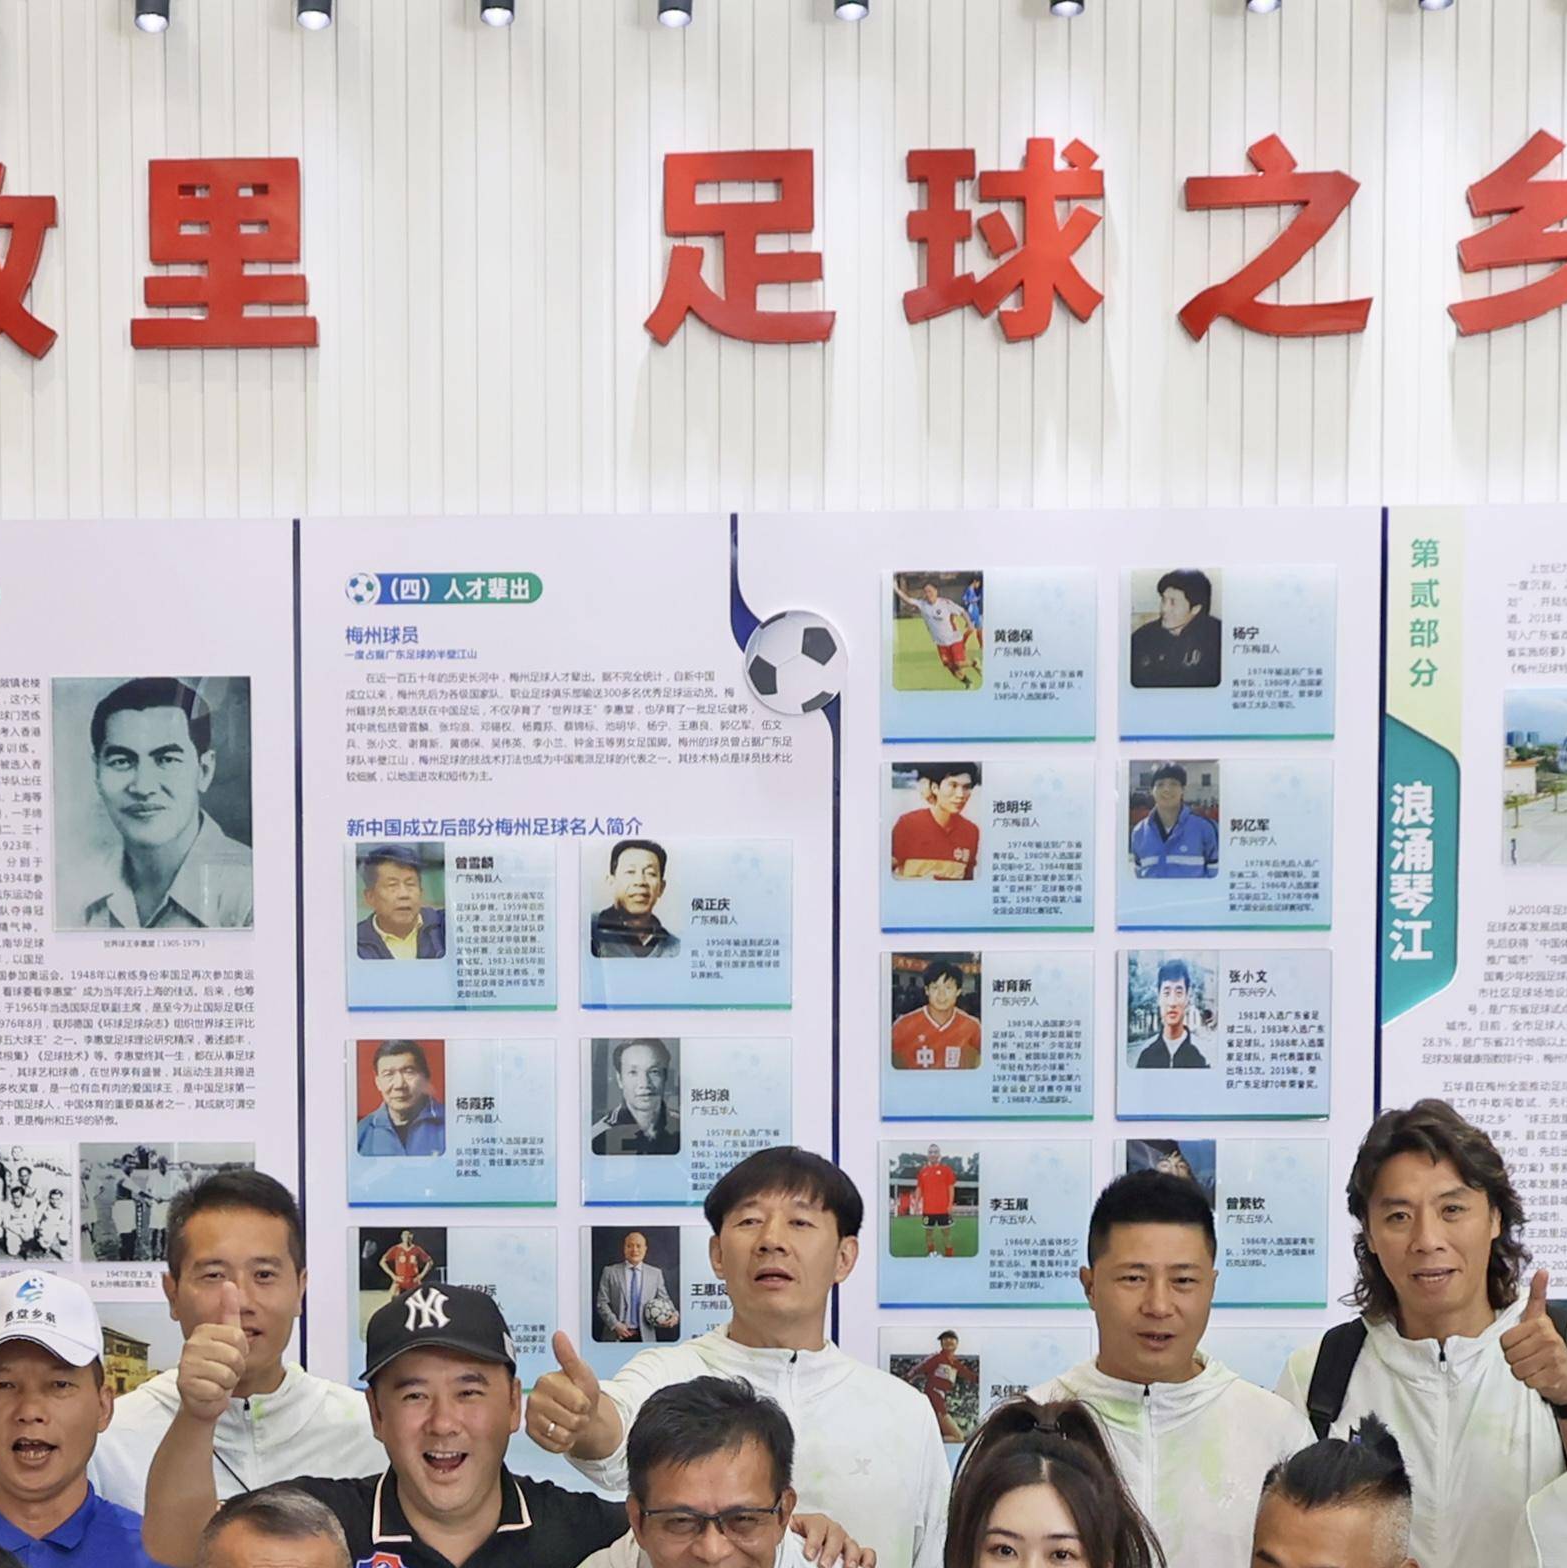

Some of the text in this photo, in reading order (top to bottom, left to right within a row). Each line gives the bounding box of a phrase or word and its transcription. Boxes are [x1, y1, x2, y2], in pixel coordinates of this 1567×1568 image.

[1409, 539, 1441, 689] 第贰部分
[345, 626, 419, 645] 梅州球员
[993, 628, 1034, 643] 黄德保
[1232, 626, 1260, 641] 杨宁
[992, 799, 1033, 815] 池明华
[346, 817, 644, 837] 新中国成立后部分梅州足球名人简介
[1229, 817, 1271, 833] 郭亿军
[455, 855, 495, 870] 曾雪麟
[1388, 780, 1435, 963] 浪涌琴江
[691, 897, 731, 912] 侯正庆
[1228, 968, 1269, 984] 张小文
[991, 977, 1033, 993] 谢育新
[690, 1087, 731, 1103] 张均浪
[989, 1197, 1030, 1211] 李玉展
[1226, 1195, 1266, 1211] 曾繁钦
[404, 1288, 450, 1329] NY
